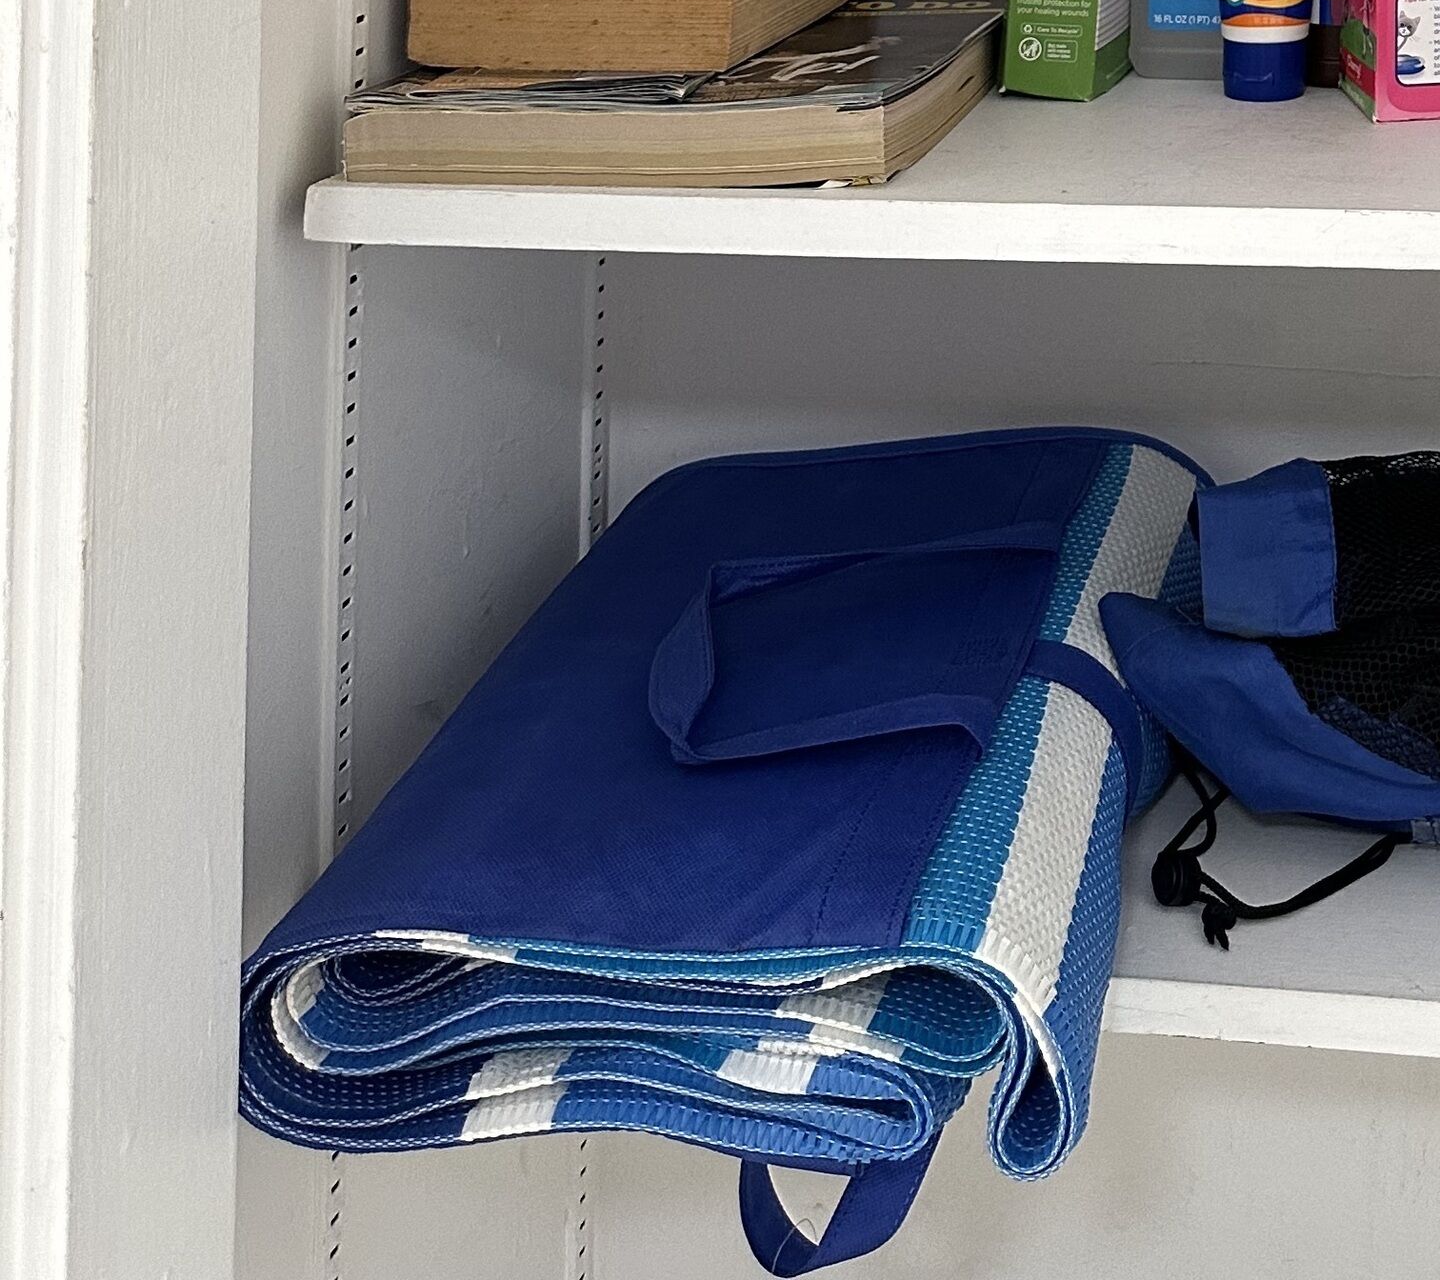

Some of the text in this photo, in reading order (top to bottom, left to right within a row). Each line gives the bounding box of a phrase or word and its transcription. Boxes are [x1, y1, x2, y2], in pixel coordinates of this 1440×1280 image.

[906, 1, 992, 11] DO
[1153, 14, 1162, 23] 16
[1163, 14, 1174, 24] FL
[1176, 14, 1187, 24] OZ
[1197, 14, 1210, 25] PT)
